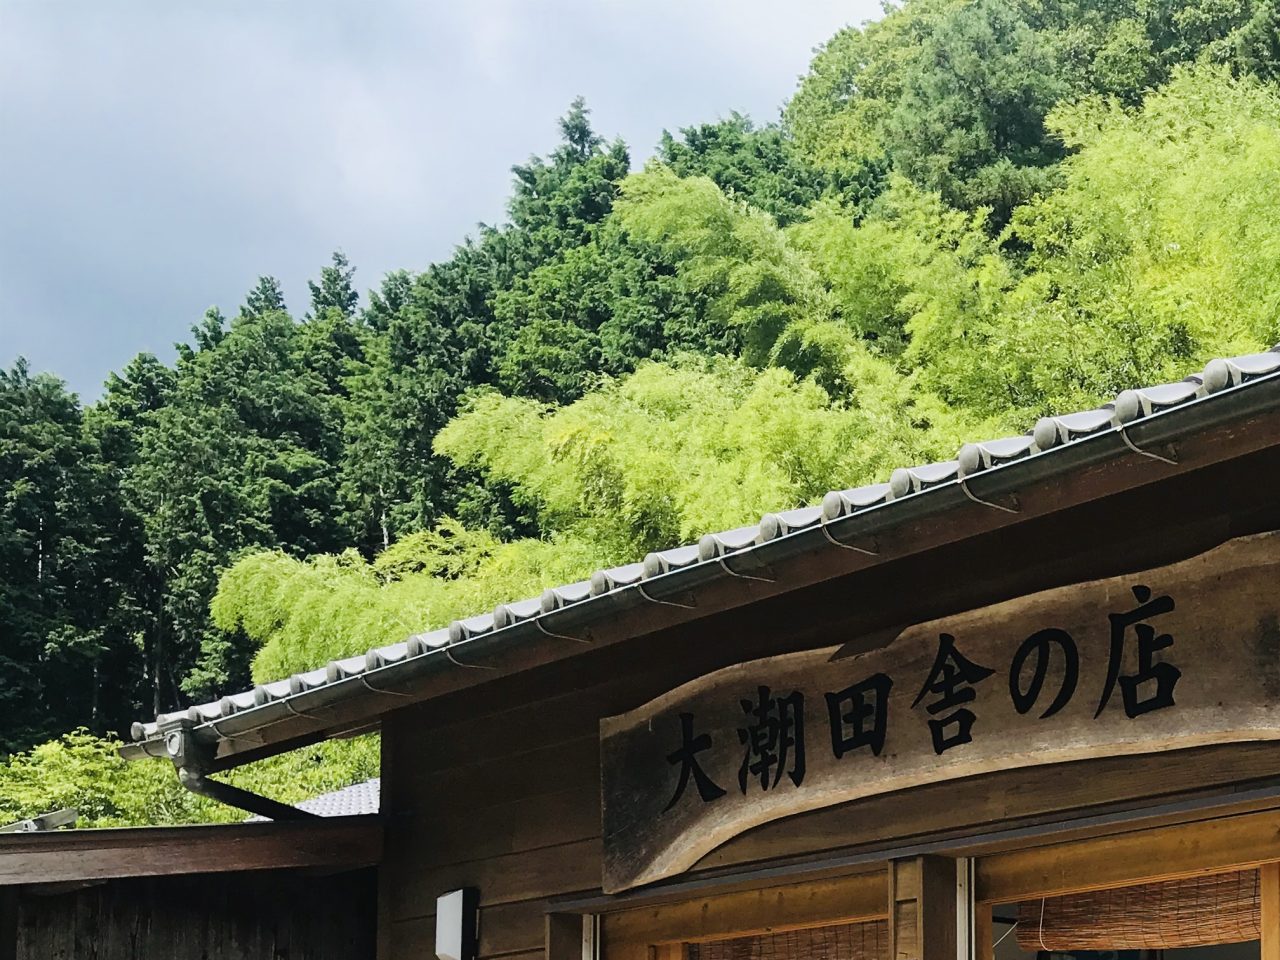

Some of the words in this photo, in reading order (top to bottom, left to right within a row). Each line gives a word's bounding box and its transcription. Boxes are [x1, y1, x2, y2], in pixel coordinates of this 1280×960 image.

[666, 585, 1182, 812] 大潮田舎の店
